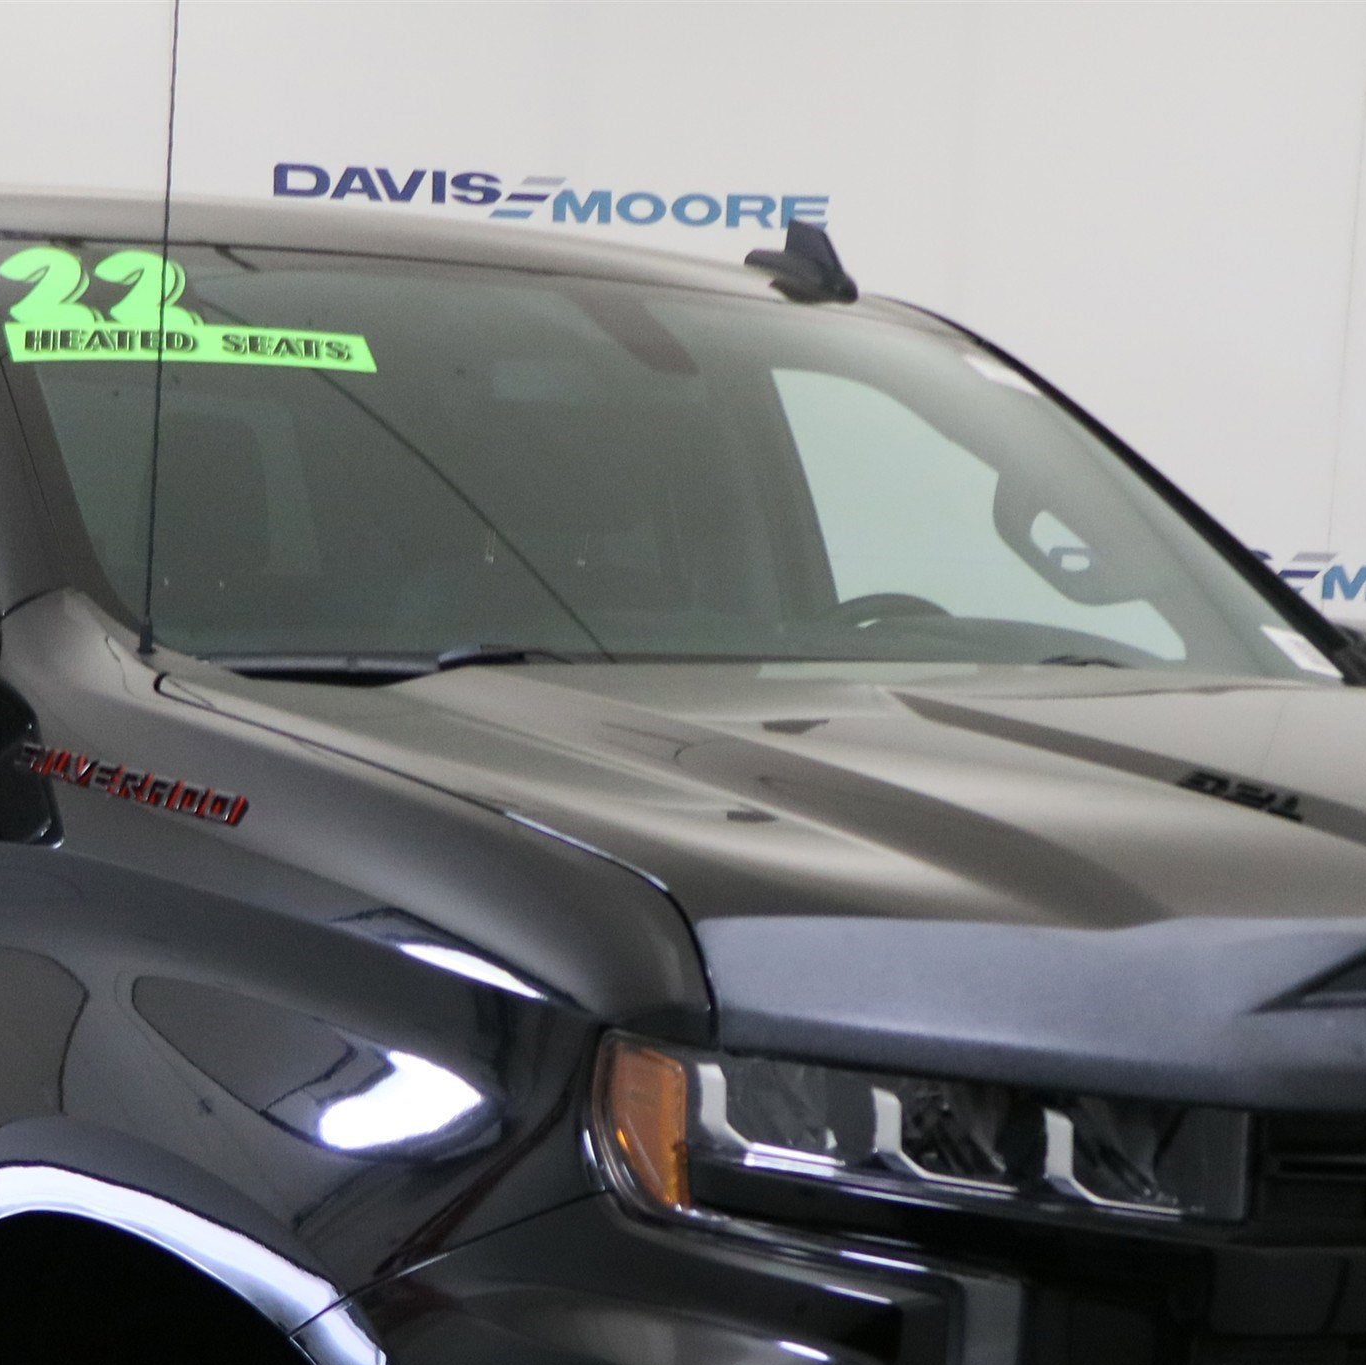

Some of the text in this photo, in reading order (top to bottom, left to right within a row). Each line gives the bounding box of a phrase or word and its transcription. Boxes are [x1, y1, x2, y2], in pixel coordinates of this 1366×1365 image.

[273, 163, 831, 230] DAVIS MOORE
[24, 329, 354, 363] HEATED SEATS
